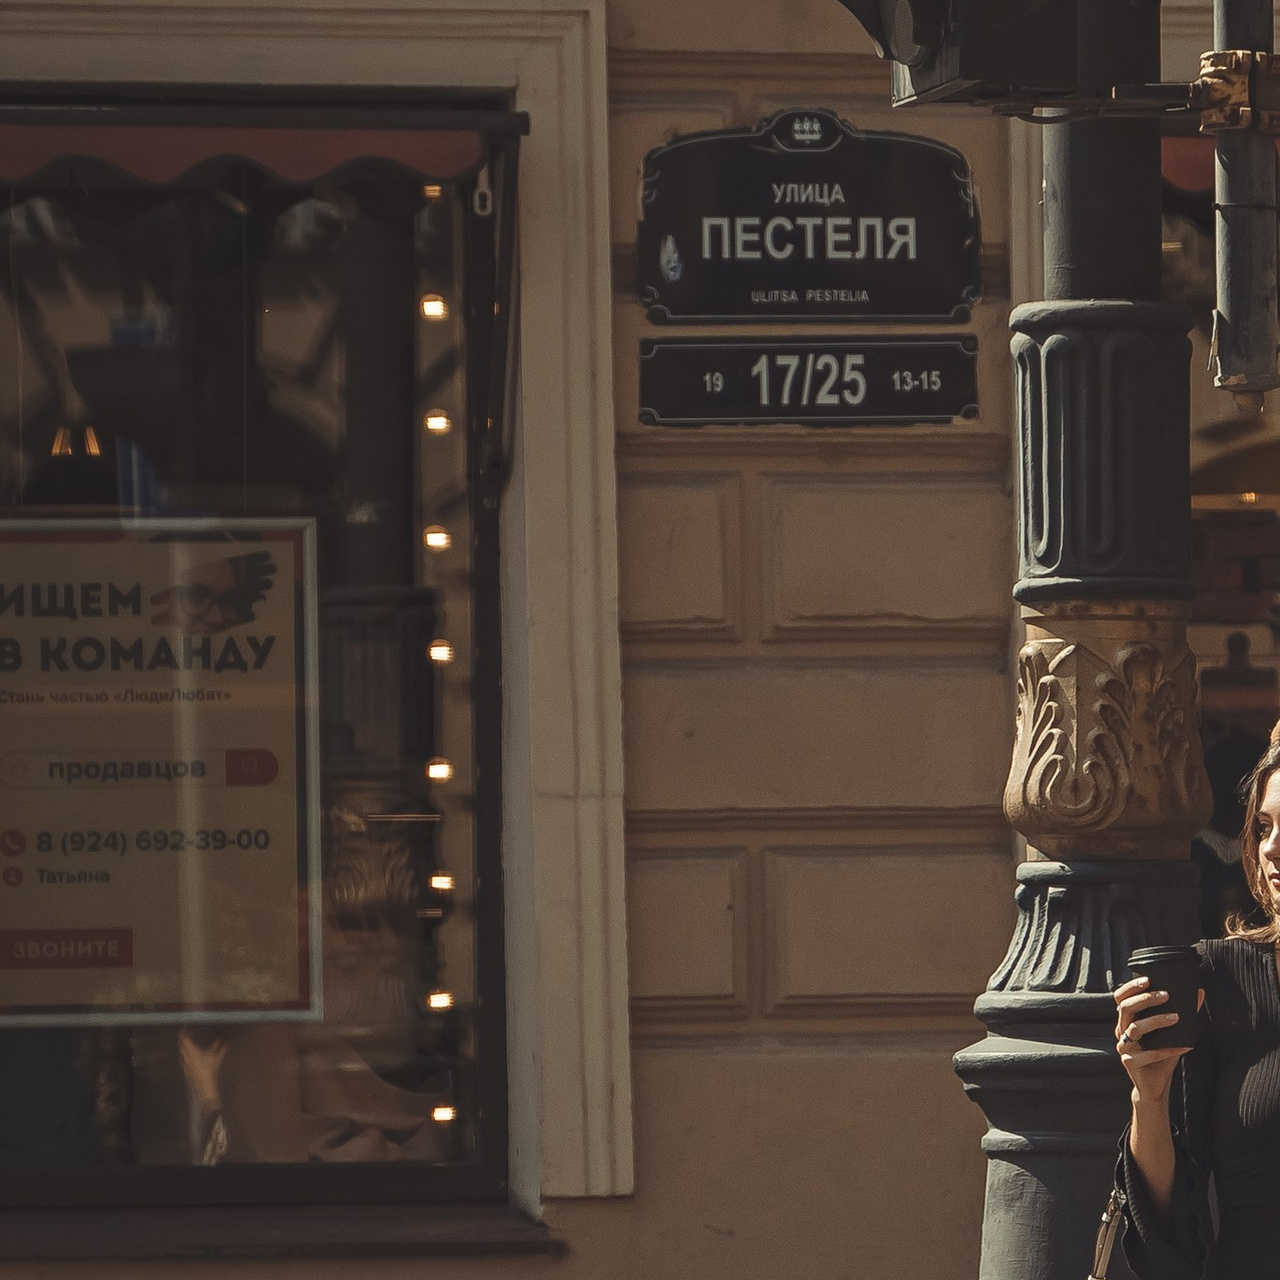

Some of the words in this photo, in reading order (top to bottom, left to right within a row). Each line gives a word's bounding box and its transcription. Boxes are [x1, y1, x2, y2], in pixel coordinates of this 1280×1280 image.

[771, 183, 845, 207] УЛИЦА
[700, 216, 918, 261] ПЕСТЕЛЯ
[751, 289, 799, 303] ULITSA
[805, 289, 870, 303] PESTELIA
[703, 371, 724, 394] 19
[751, 353, 868, 407] 17/25
[892, 370, 942, 393] 13-15
[0, 582, 142, 619] ИЩЕМ
[40, 635, 277, 674] КОМАНДУ
[48, 758, 207, 785] продавцов
[36, 831, 53, 853] 8
[61, 830, 128, 858] (924)
[136, 828, 271, 853] 692-39-00
[36, 868, 110, 885] Татьяна
[13, 939, 119, 960] ЗВОНИТЕ
